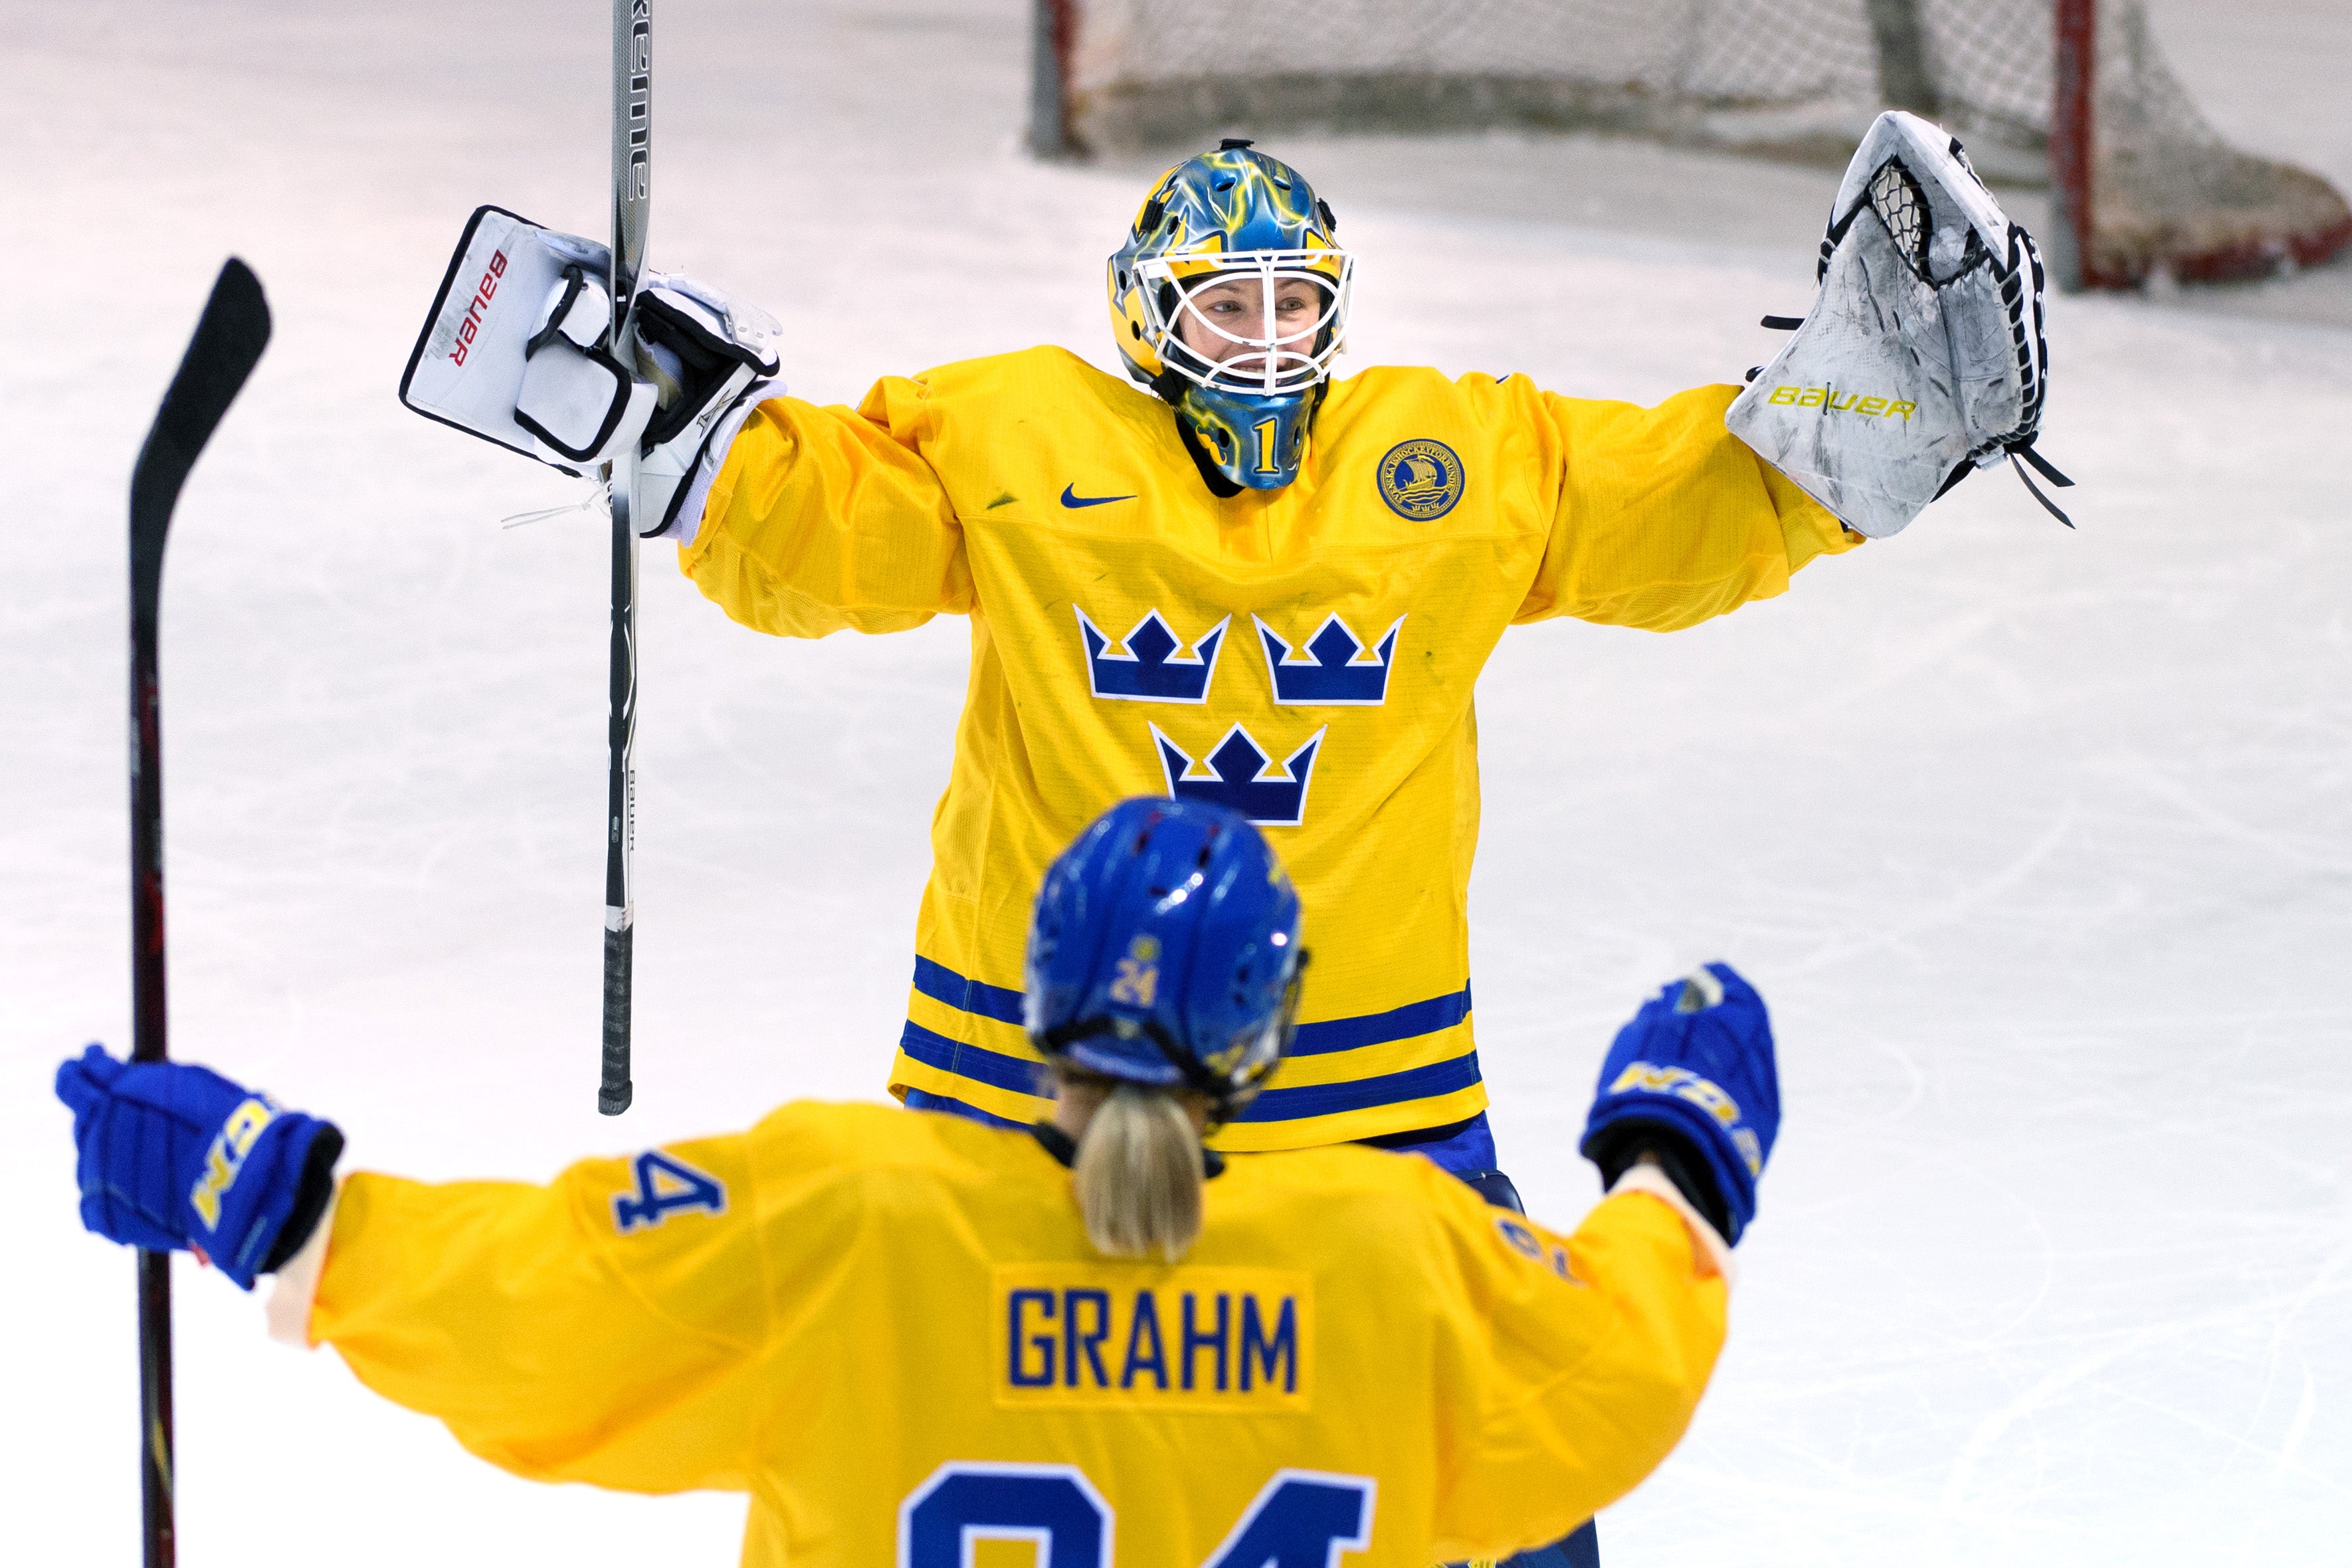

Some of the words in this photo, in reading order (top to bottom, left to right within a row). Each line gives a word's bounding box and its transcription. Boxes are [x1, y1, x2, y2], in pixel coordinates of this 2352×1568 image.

[1252, 417, 1280, 474] 1
[1109, 957, 1159, 1007] 24
[191, 1095, 276, 1234] CM
[1008, 1288, 1298, 1394] GRAHM
